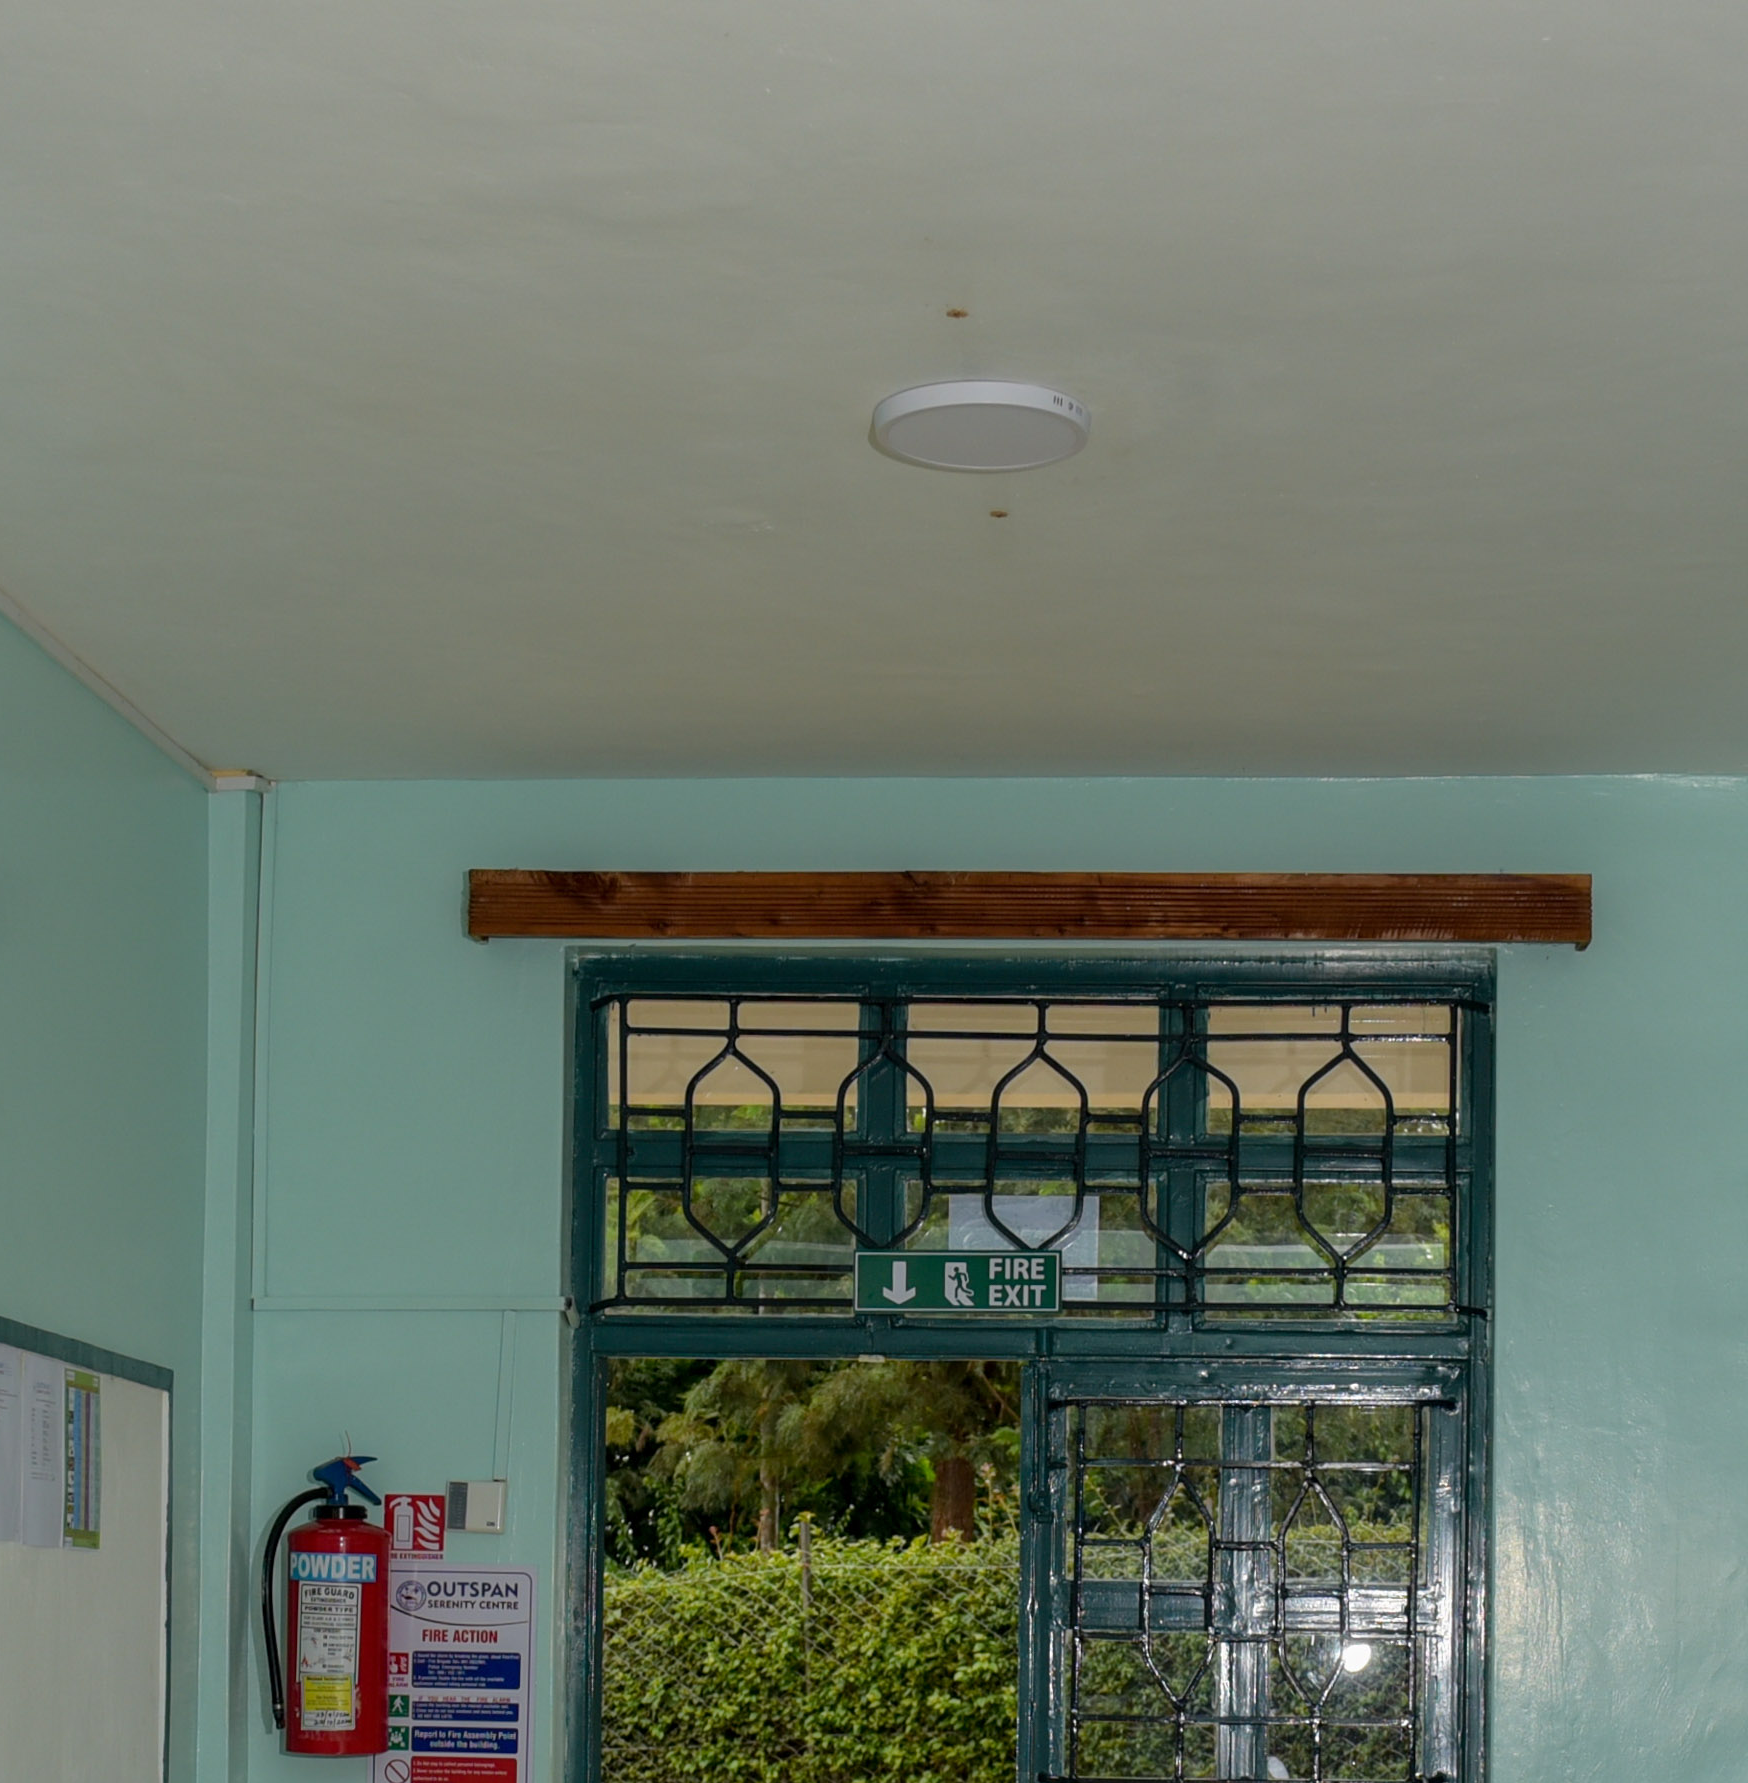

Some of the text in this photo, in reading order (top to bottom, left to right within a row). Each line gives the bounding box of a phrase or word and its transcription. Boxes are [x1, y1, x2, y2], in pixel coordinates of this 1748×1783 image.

[989, 1258, 1045, 1280] FIRE
[989, 1285, 1047, 1307] EXIT
[290, 1554, 375, 1580] POWDER
[305, 1587, 355, 1600] FIRE GUARD
[427, 1581, 519, 1598] OUTSPAN
[427, 1599, 519, 1610] SERENITY CENTRE
[422, 1629, 498, 1644] FIRE ACTION
[414, 1730, 517, 1741] Report to Fire Assembly Point
[456, 1741, 468, 1749] the
